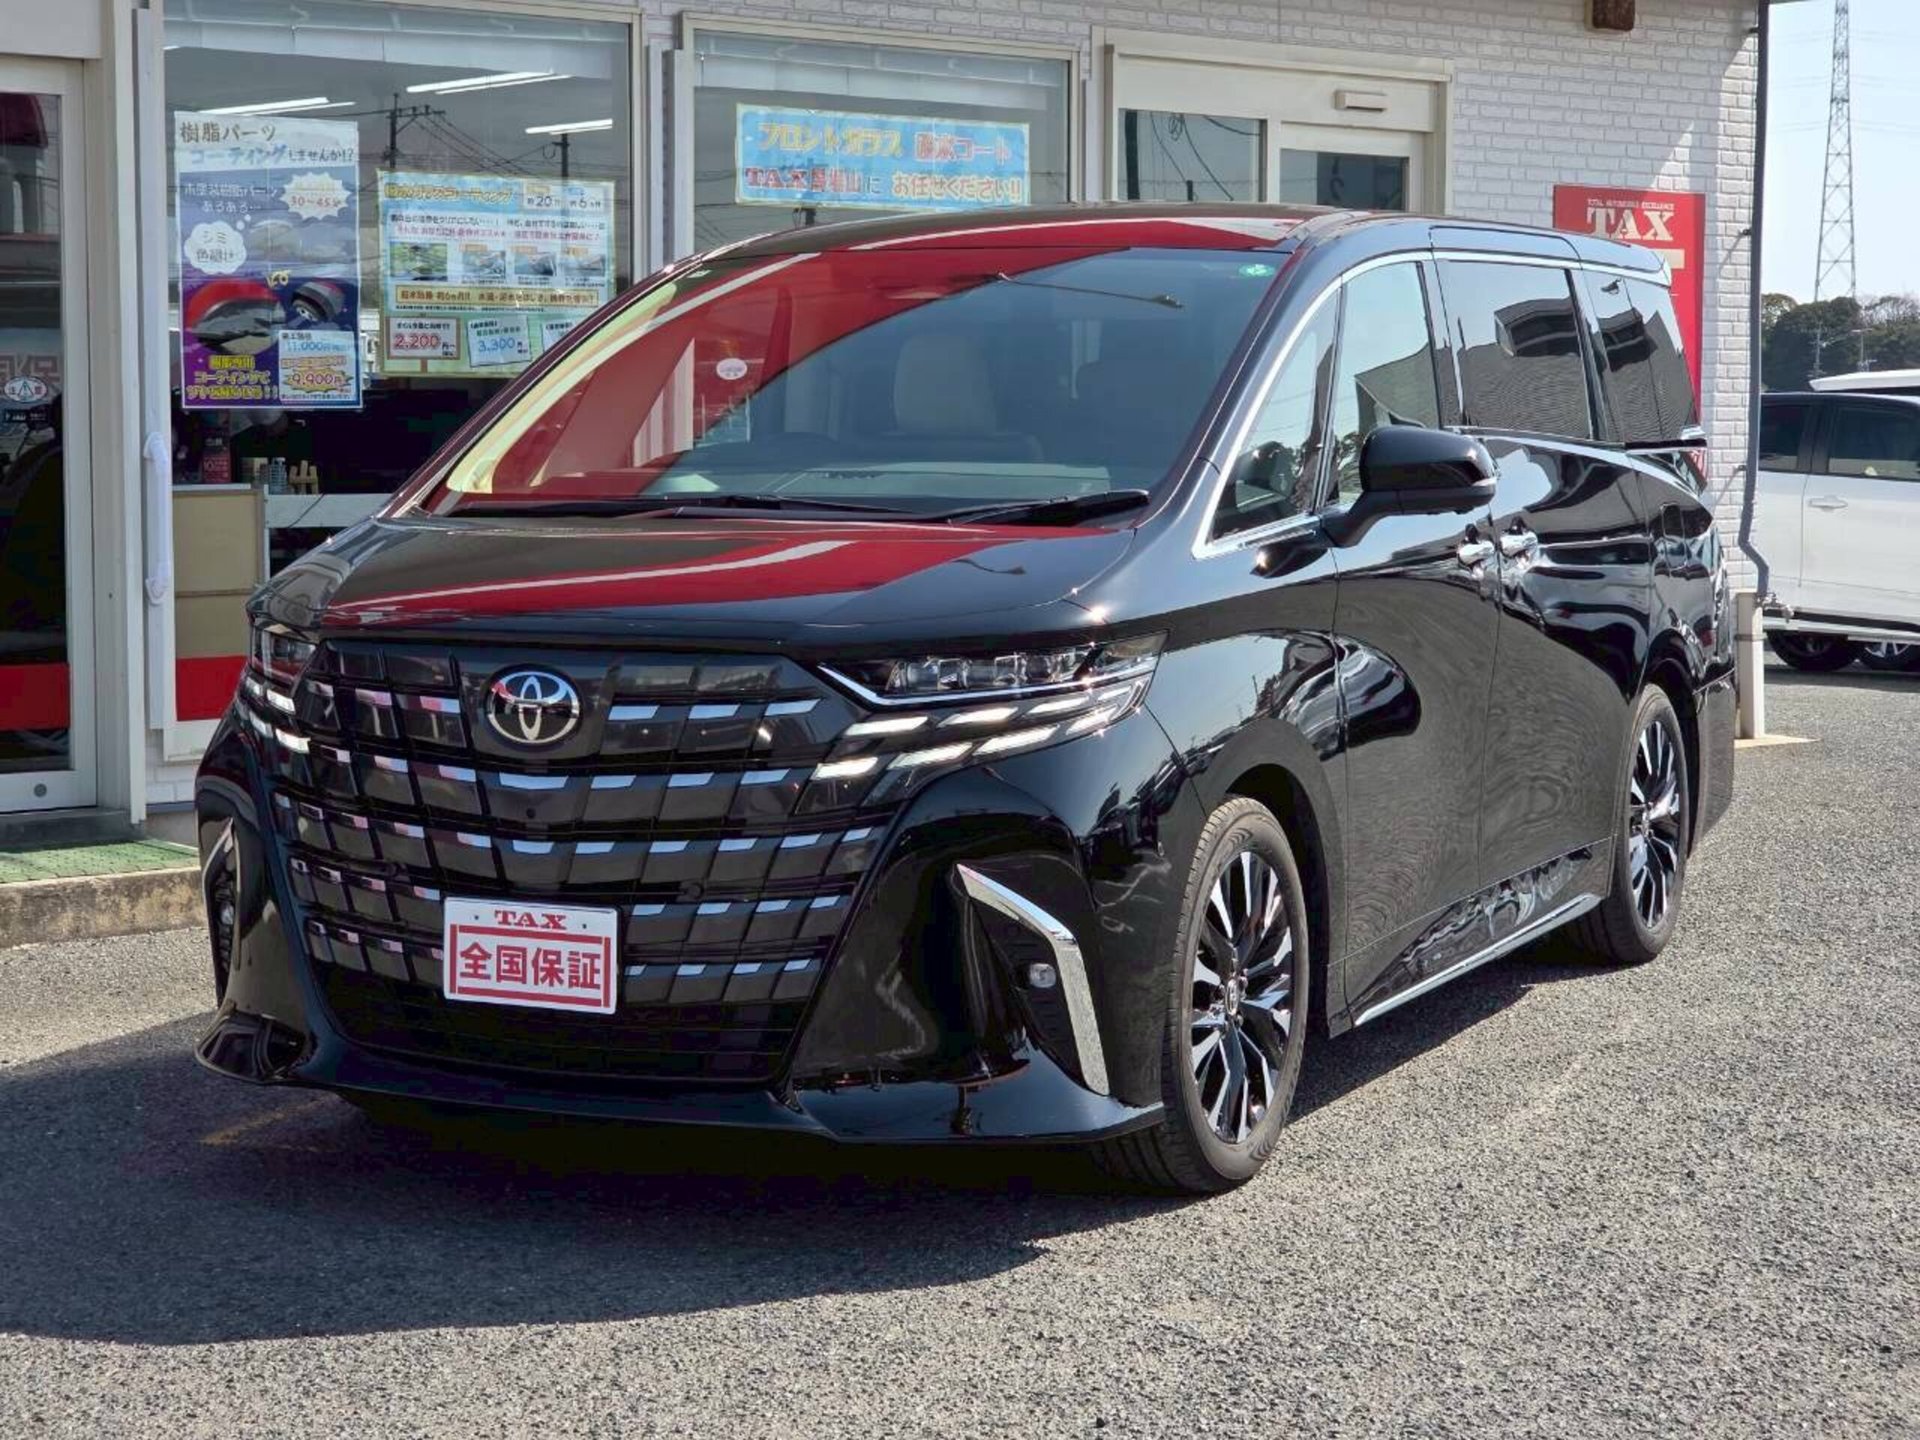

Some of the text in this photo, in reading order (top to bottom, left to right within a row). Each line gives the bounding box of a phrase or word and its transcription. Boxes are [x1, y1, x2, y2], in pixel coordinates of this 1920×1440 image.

[180, 121, 277, 143] 樹脂パーツ
[1586, 207, 1674, 241] TAX
[494, 909, 568, 931] TAX
[459, 941, 602, 991] 全国保証
